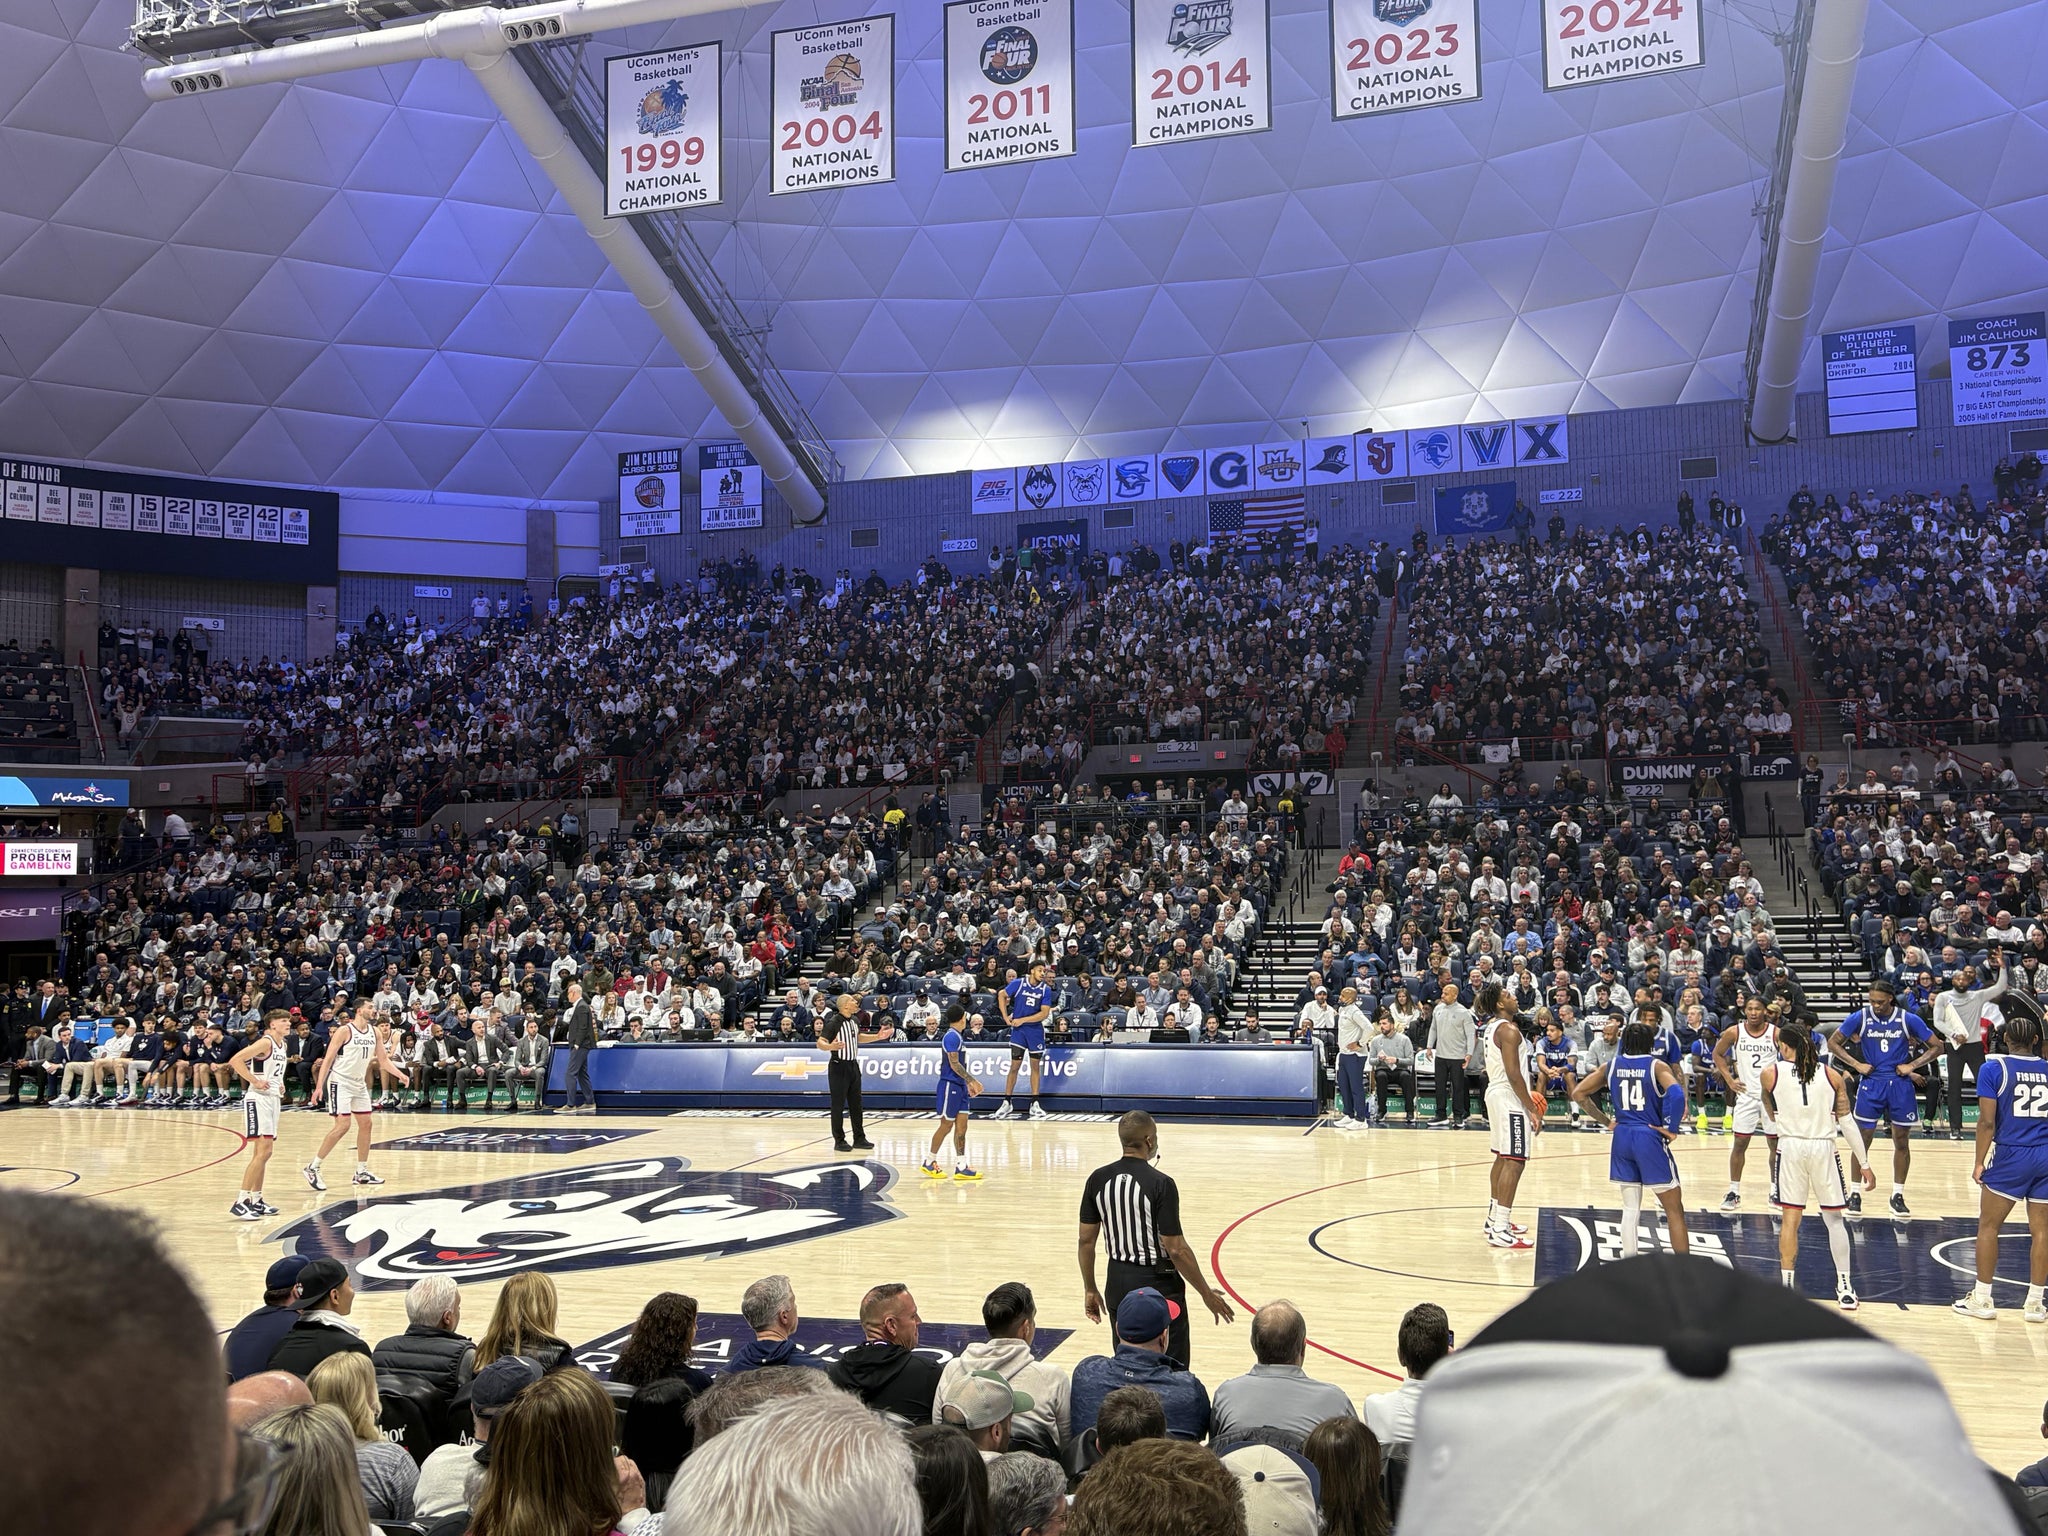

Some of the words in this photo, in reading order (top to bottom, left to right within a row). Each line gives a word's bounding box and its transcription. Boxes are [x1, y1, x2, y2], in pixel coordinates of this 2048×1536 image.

[968, 0, 1010, 14] UConn
[1187, 2, 1232, 21] FINAL
[976, 9, 1041, 28] Basketball
[1560, 0, 1683, 40] 2024
[795, 29, 834, 42] UConn
[837, 23, 871, 36] Men's
[802, 37, 863, 55] Basketball
[996, 39, 1031, 54] FINAL
[1347, 24, 1459, 71] 2023
[1571, 31, 1674, 59] NATIONAL
[627, 56, 664, 69] UConn
[668, 50, 700, 64] Men's
[1563, 50, 1683, 80] CHAMPIONS
[634, 64, 692, 82] Basketball
[1151, 57, 1251, 100] 2014
[1358, 64, 1453, 90] NATIONAL
[801, 76, 826, 86] NCAA
[800, 81, 841, 101] Final
[1350, 83, 1462, 110] CHAMPIONS
[804, 101, 820, 109] 2004
[967, 84, 1050, 125] 2011
[1157, 96, 1246, 119] NATIONAL
[781, 111, 883, 151] 2004
[968, 122, 1052, 144] NATIONAL
[1149, 114, 1254, 139] CHAMPIONS
[620, 136, 705, 174] 1999
[792, 148, 872, 168] NATIONAL
[961, 139, 1059, 164] CHAMPIONS
[625, 171, 701, 192] NATIONAL
[786, 165, 879, 187] CHAMPIONS
[619, 188, 708, 210] CHAMPIONS
[1976, 318, 2017, 330] COACH
[1839, 329, 1897, 343] NATIONAL
[1958, 333, 1976, 344] JIM
[1980, 328, 2038, 342] CALHOUN
[1846, 339, 1891, 350] PLAYER
[1831, 351, 1845, 361] OF
[1851, 348, 1873, 357] THE
[1877, 345, 1908, 355] YEAR
[1967, 343, 2031, 371] 873
[1828, 367, 1867, 377] OKAFOR
[1974, 370, 2004, 378] CAREER
[1965, 378, 1993, 389] National
[1993, 375, 2042, 387] Championships
[1986, 389, 2002, 398] Final
[2004, 388, 2022, 397] Fours
[1957, 404, 1964, 412] 17
[1966, 402, 1978, 411] BIG
[1978, 400, 1996, 410] EAST
[1997, 397, 2047, 409] Championships
[1958, 414, 1976, 423] 2005
[1977, 412, 1990, 421] Hall
[1991, 411, 1999, 420] of
[1999, 410, 2017, 419] Fame
[2018, 408, 2047, 418] Inductee
[1464, 424, 1510, 467] V
[1517, 420, 1565, 462] X
[625, 453, 640, 467] JIM
[642, 450, 678, 465] CALHOUN
[3, 462, 17, 478] OF
[21, 464, 61, 483] HONOR
[622, 466, 646, 474] CLASS
[1210, 451, 1249, 489] G
[977, 487, 1014, 498] EAST
[981, 480, 1007, 490] BIG
[1558, 489, 1582, 500] 222
[140, 497, 157, 511] 15
[167, 499, 190, 514] 22
[201, 503, 217, 517] 13
[227, 505, 250, 519] 22
[256, 508, 278, 522] 42
[707, 509, 720, 522] JIM
[723, 507, 756, 521] CALHOUN
[703, 521, 736, 529] FOUNDING
[738, 519, 761, 527] CLASS
[943, 542, 956, 550] SEC
[957, 539, 977, 550] 220
[436, 587, 449, 597] 10
[212, 620, 220, 629] 9
[1178, 742, 1197, 751] 221
[1622, 764, 1696, 780] DUNKIN'
[1636, 785, 1662, 796] 222
[1845, 803, 1873, 812] 123
[11, 853, 71, 861] PROBLEM
[331, 851, 344, 859] SEC
[10, 862, 71, 870] GAMBLING
[1867, 1029, 1885, 1038] Seton
[1885, 1028, 1902, 1038] Hall
[362, 1047, 369, 1059] 11
[1740, 1044, 1773, 1052] UCONN
[1880, 1039, 1889, 1053] 6
[857, 1055, 942, 1080] Togethe
[1752, 1054, 1762, 1068] 2
[2016, 1072, 2047, 1083] FISHER
[1619, 1080, 1646, 1111] 14
[1799, 1081, 1809, 1106] 1
[2013, 1083, 2048, 1117] 22
[422, 1132, 626, 1142] MADISON
[1513, 1116, 1522, 1154] HUSKIES
